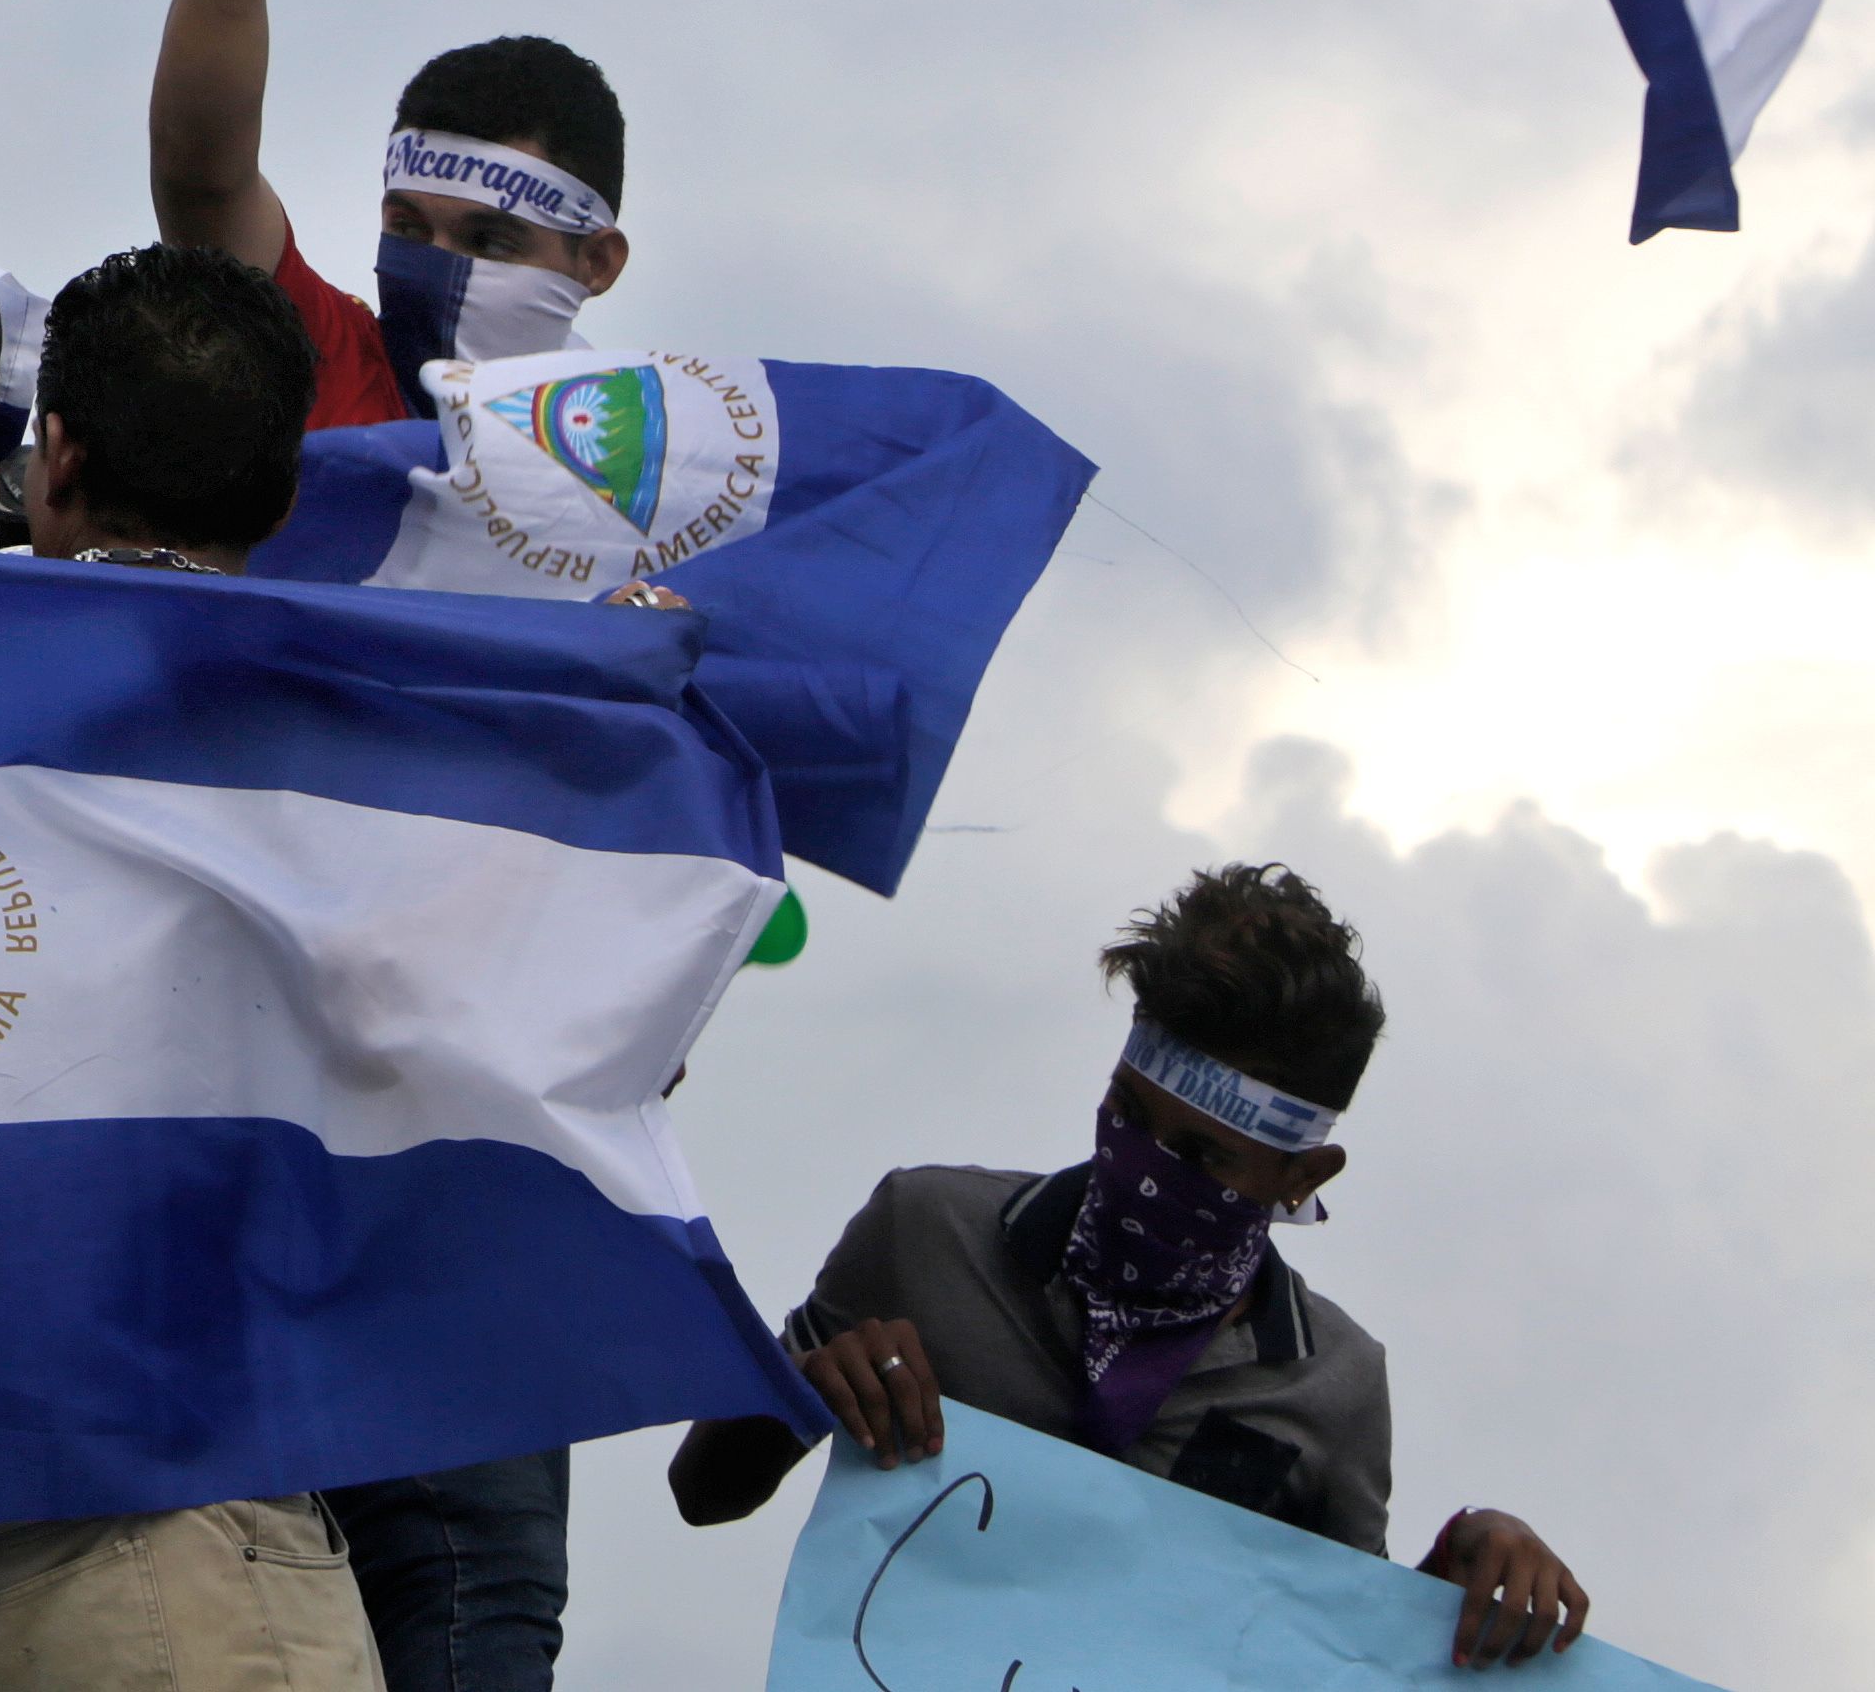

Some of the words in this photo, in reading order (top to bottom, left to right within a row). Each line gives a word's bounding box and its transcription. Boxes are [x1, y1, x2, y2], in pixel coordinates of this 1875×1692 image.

[390, 131, 565, 215] Nicaragua
[649, 350, 764, 441] CENTR
[631, 455, 765, 578] AMERICA
[1174, 1070, 1261, 1131] DANIEL
